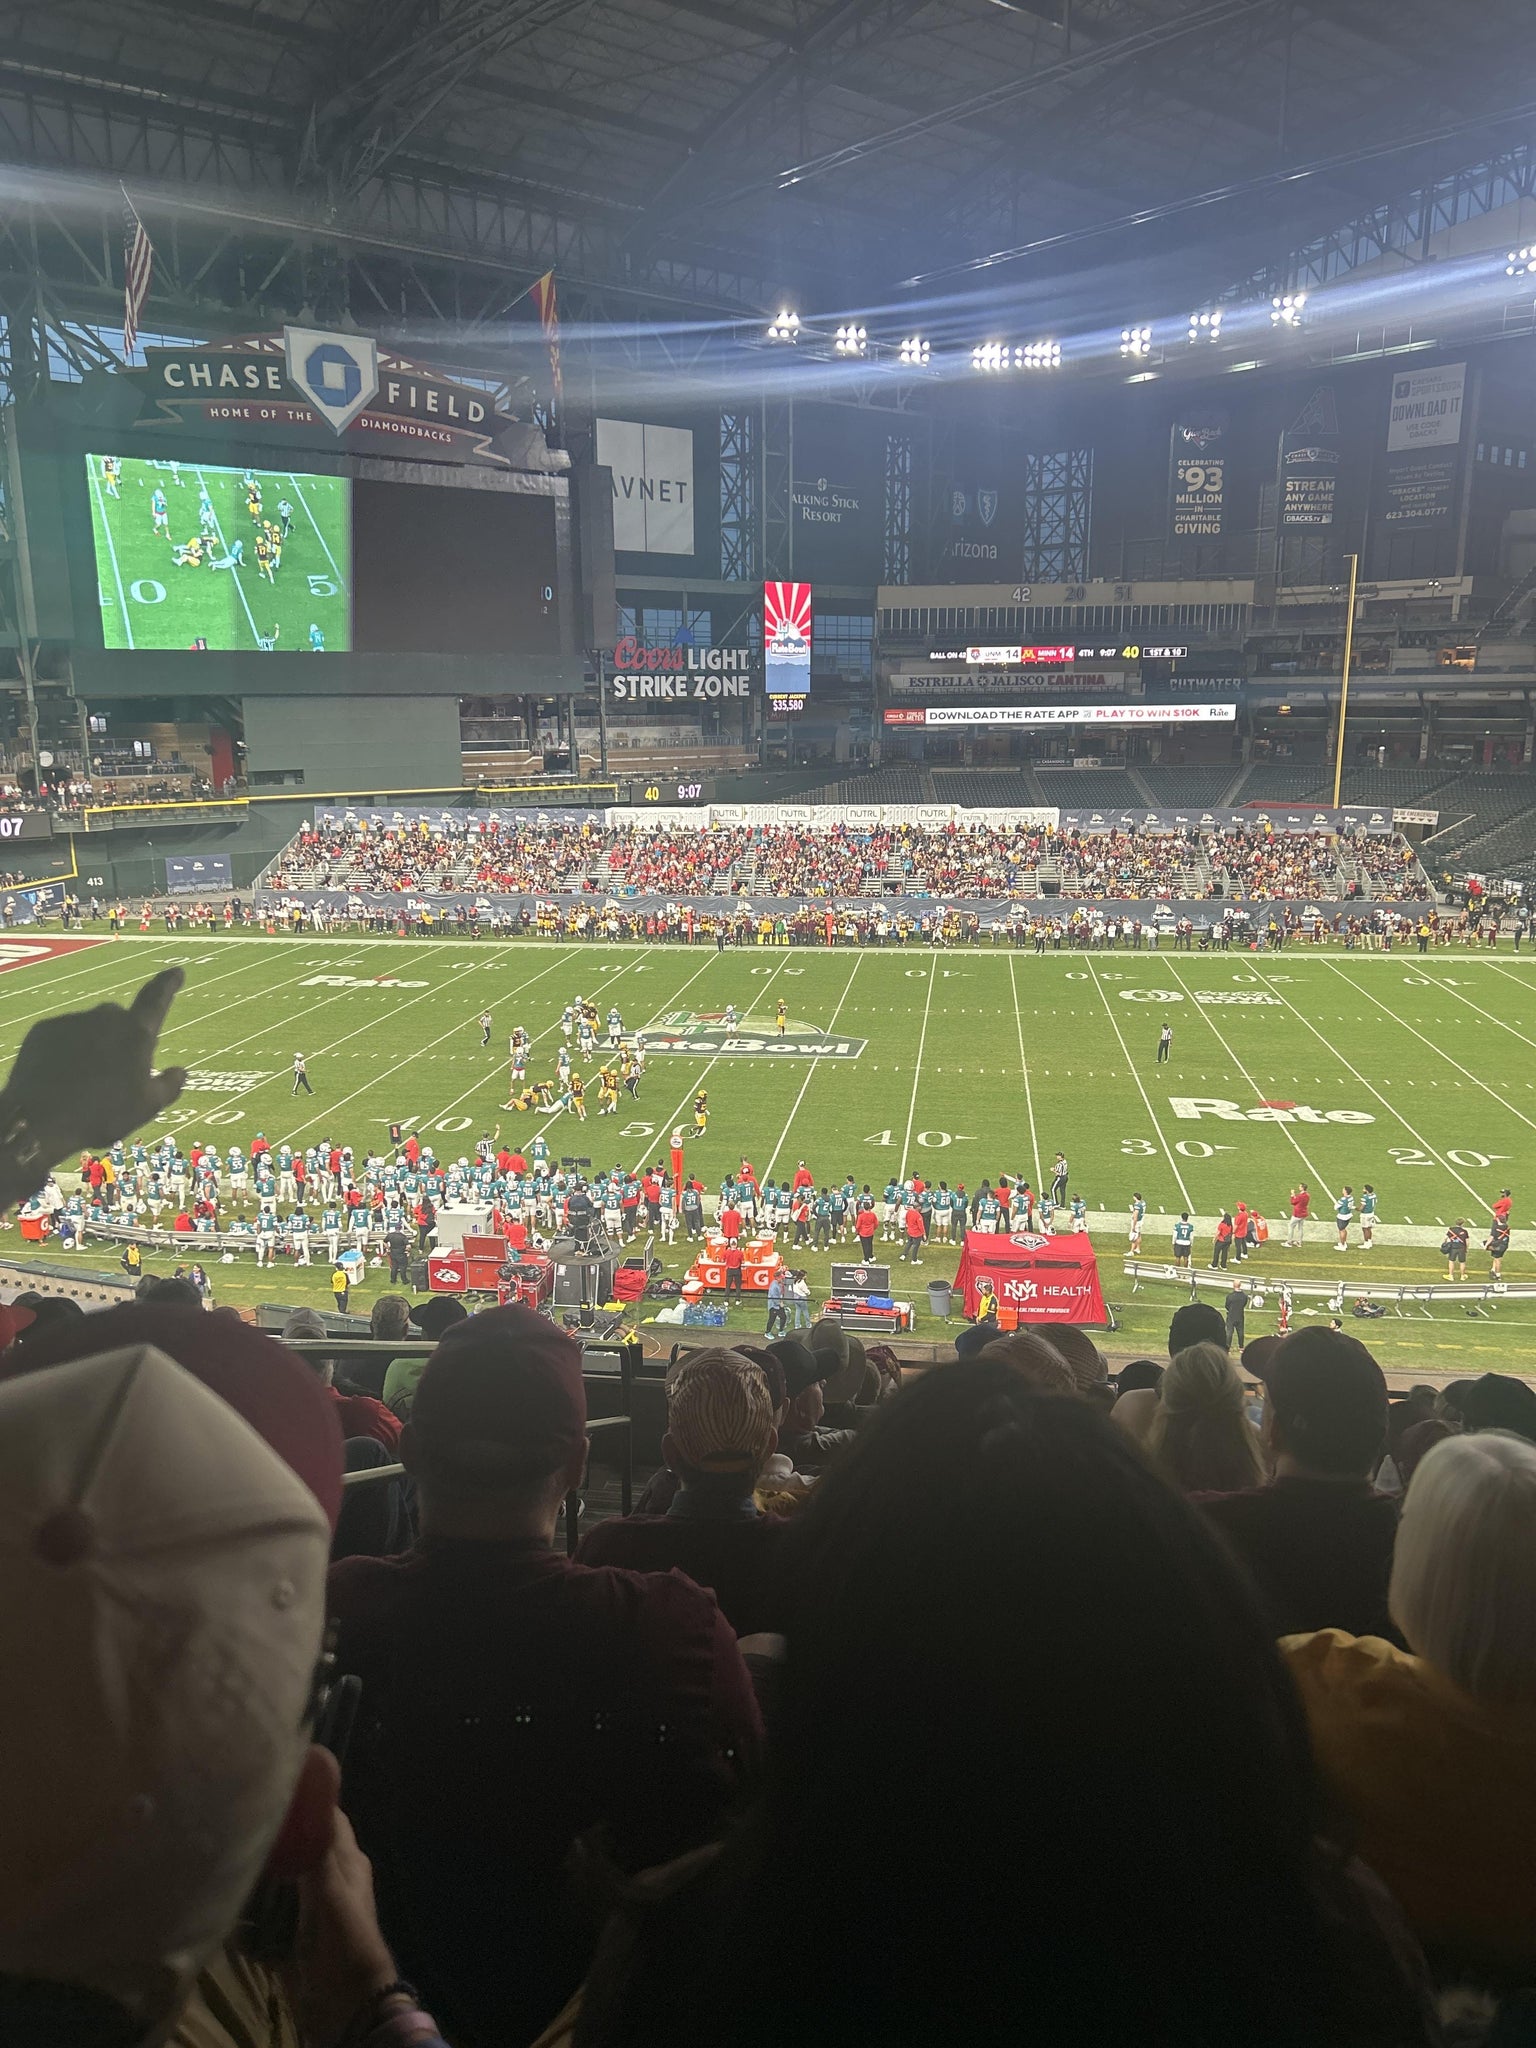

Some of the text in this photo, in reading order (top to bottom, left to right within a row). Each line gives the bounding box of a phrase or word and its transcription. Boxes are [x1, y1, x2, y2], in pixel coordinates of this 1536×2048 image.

[164, 363, 485, 423] CHASE FIELD
[1392, 397, 1461, 421] DOWNLOAD IT
[210, 407, 452, 442] HOME OF THE DIAMONDBACKS
[1177, 466, 1223, 492] $93
[1286, 481, 1335, 491] STREAM
[792, 494, 829, 507] ALKING
[1176, 494, 1222, 503] MILLION
[1308, 493, 1334, 501] GAME
[1400, 493, 1435, 501] LOCATION
[1175, 523, 1220, 534] GIVING
[1013, 585, 1133, 601] 42 20 51
[614, 636, 749, 670] Coors LIGHT
[1005, 649, 1019, 658] 14
[1059, 648, 1073, 659] 14
[1079, 649, 1094, 657] 4TH
[1100, 649, 1116, 657] 9:07
[1122, 646, 1139, 659] 40
[1172, 648, 1182, 656] 10
[613, 675, 750, 698] STRIKE ZONE
[909, 674, 1106, 687] ESTRELLA JALISCO CANTINA
[1170, 677, 1242, 692] CUTWATER
[773, 699, 803, 711] $35,580
[929, 710, 998, 720] DOWNLOAD
[999, 710, 1022, 719] THE
[1024, 710, 1055, 719] RATE
[1057, 709, 1079, 718] APP
[1096, 709, 1125, 718] PLAY
[1128, 709, 1146, 718] TO
[1147, 709, 1170, 717] WIN
[1209, 707, 1229, 717] Rate
[645, 784, 701, 800] 40 9:07
[713, 809, 739, 818] NUTRL
[781, 809, 807, 819] NUTRL
[850, 809, 878, 818] NUTRL
[920, 809, 948, 818] NUTRL
[87, 876, 103, 886] 413
[407, 897, 431, 910] Rate
[298, 975, 431, 988] Rate
[600, 1036, 850, 1054] Rate Bowl
[185, 1078, 257, 1087] OWL
[1168, 1097, 1376, 1125] Rate
[618, 1121, 707, 1139] 50
[863, 1129, 952, 1148] 40
[1120, 1138, 1214, 1158] 30
[232, 1158, 243, 1168] 55
[1387, 1148, 1490, 1168] 20
[385, 1178, 396, 1188] 84
[481, 1188, 491, 1198] 57
[627, 1188, 637, 1198] 55
[509, 1195, 520, 1205] 74
[607, 1199, 617, 1209] 93
[834, 1198, 843, 1207] 10
[984, 1205, 995, 1214] 56
[326, 1215, 335, 1225] 14
[357, 1213, 363, 1222] 5
[389, 1213, 400, 1223] 25
[40, 1217, 50, 1231] G
[263, 1219, 270, 1229] 8
[292, 1220, 303, 1230] 23
[1182, 1229, 1188, 1238] 4
[705, 1268, 721, 1285] G
[753, 1269, 769, 1286] G
[1043, 1285, 1092, 1297] HEALTH
